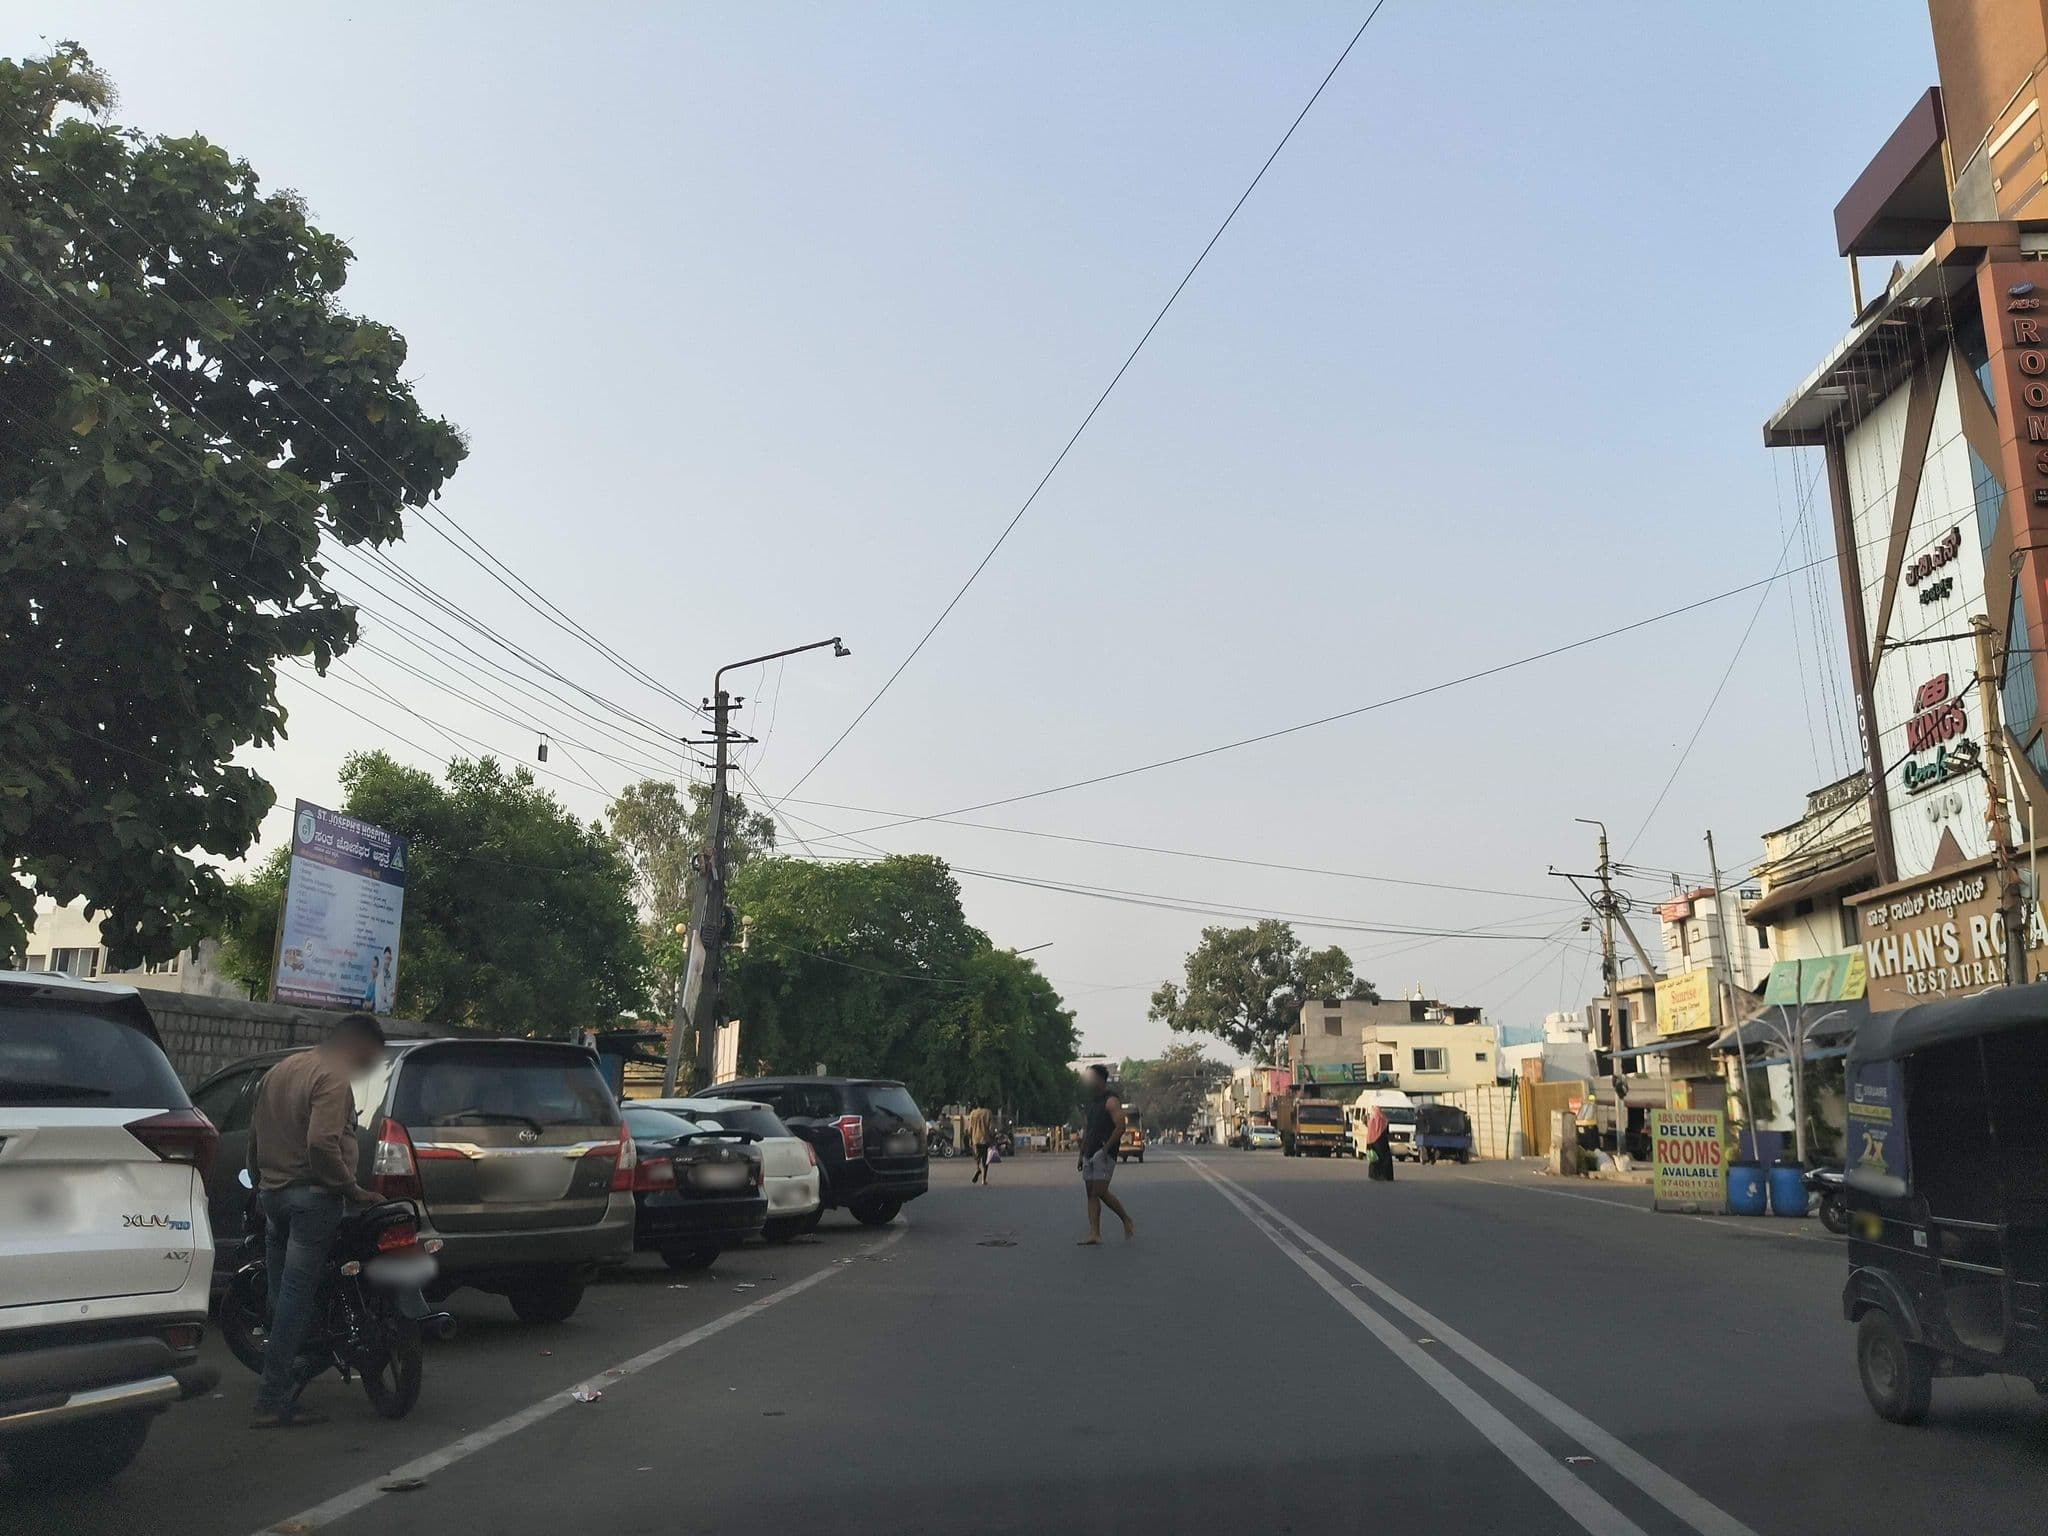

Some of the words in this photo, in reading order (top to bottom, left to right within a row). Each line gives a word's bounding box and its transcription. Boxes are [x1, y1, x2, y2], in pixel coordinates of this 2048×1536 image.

[1906, 697, 1967, 754] KINGS
[361, 824, 392, 845] HOSPITAL
[1866, 921, 1960, 979] KHAN'S
[1674, 1113, 1717, 1124] COMFORTS
[1660, 1125, 1716, 1137] DELUXE
[1657, 1139, 1721, 1165] ROOMS
[1662, 1167, 1719, 1178] AVAILABLE
